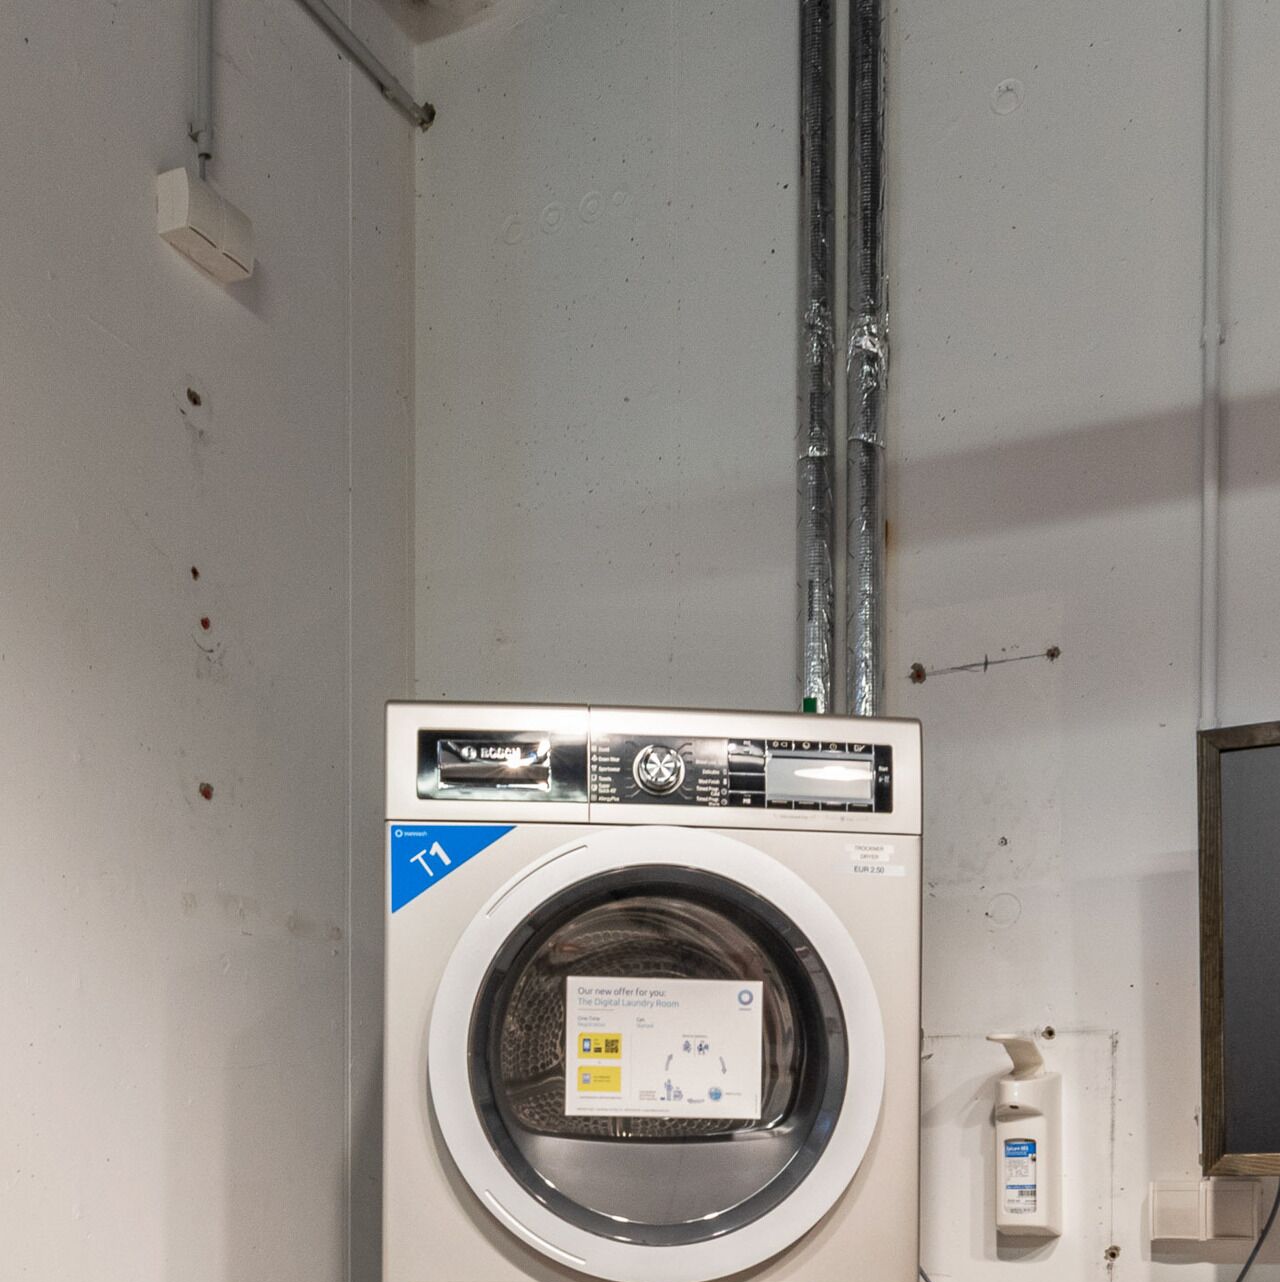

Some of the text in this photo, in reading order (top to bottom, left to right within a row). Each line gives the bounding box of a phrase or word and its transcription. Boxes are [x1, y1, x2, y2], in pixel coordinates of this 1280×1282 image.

[410, 841, 452, 877] T1
[578, 987, 594, 996] Our
[614, 987, 634, 996] offer
[635, 987, 647, 997] for
[649, 990, 666, 998] you:
[578, 997, 679, 1009] The Digital Laundry Room
